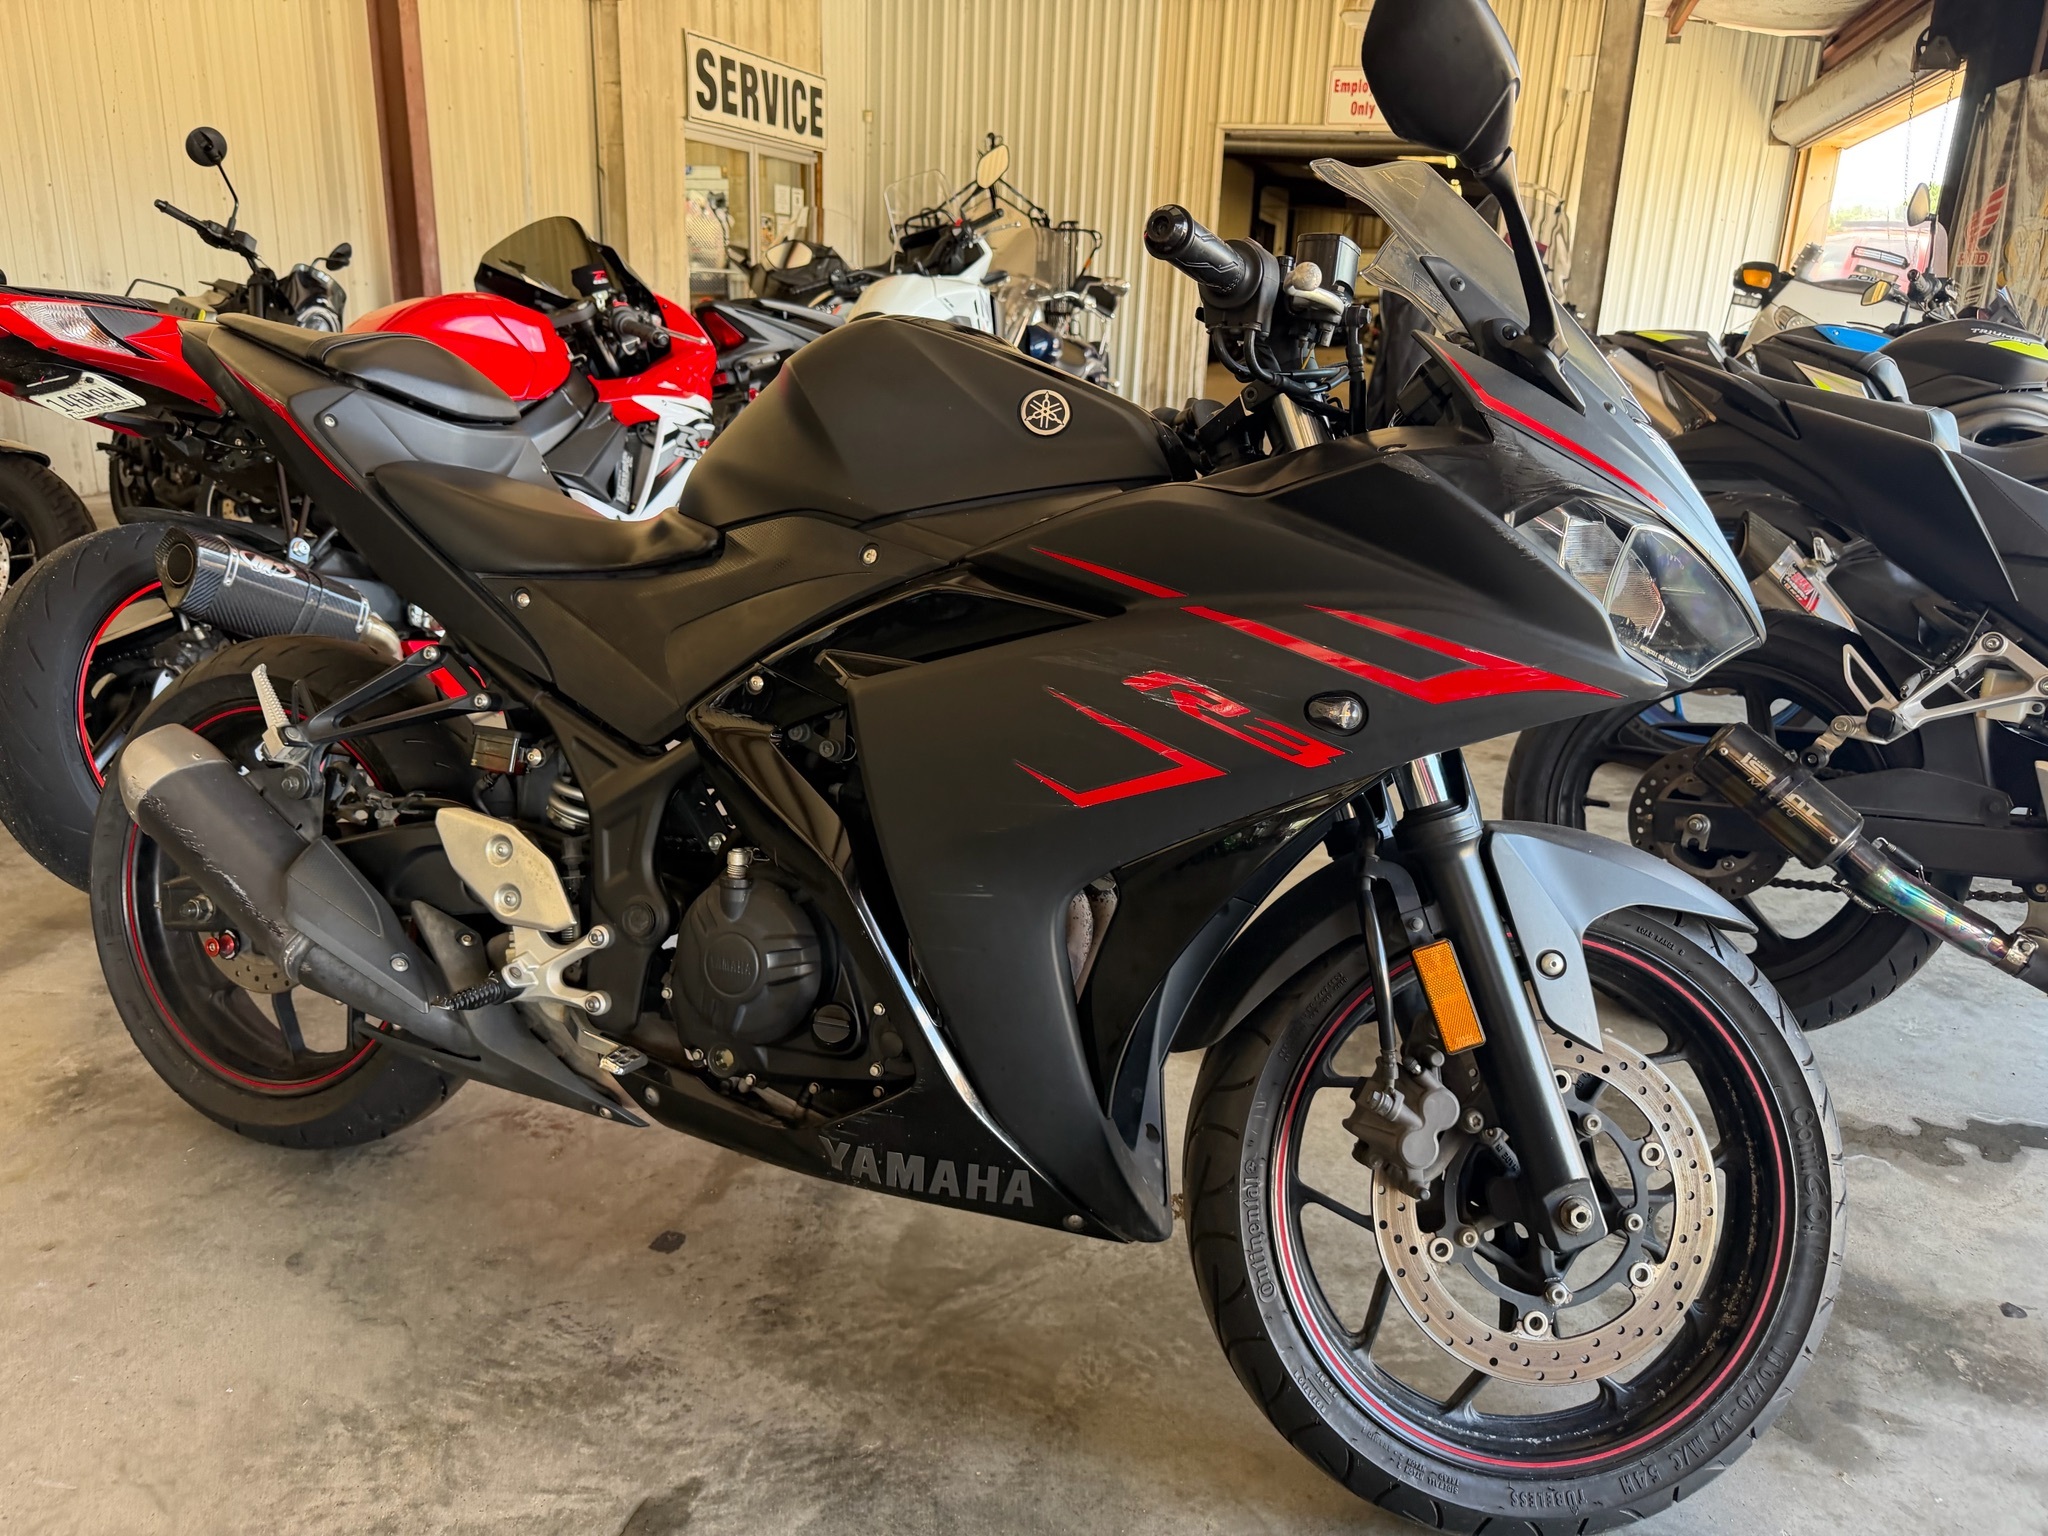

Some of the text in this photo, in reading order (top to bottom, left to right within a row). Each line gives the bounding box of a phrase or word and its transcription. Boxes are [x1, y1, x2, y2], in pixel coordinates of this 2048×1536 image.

[696, 48, 823, 138] SERVICE
[1334, 79, 1372, 96] Emplo
[1350, 101, 1375, 119] Only
[46, 387, 127, 412] 146M9W
[1636, 926, 1655, 938] LOAD
[1654, 935, 1676, 951] RANGE
[818, 1135, 1034, 1208] YAMAHA
[1243, 1177, 1277, 1303] Continental
[1294, 1370, 1326, 1413] ROTATION
[1315, 1370, 1338, 1398] FRONT
[1403, 1465, 1425, 1480] NYLON
[1427, 1476, 1459, 1494] SIDEWALL
[1619, 1462, 1663, 1495] 54H
[1510, 1489, 1588, 1508] TUBELESS
